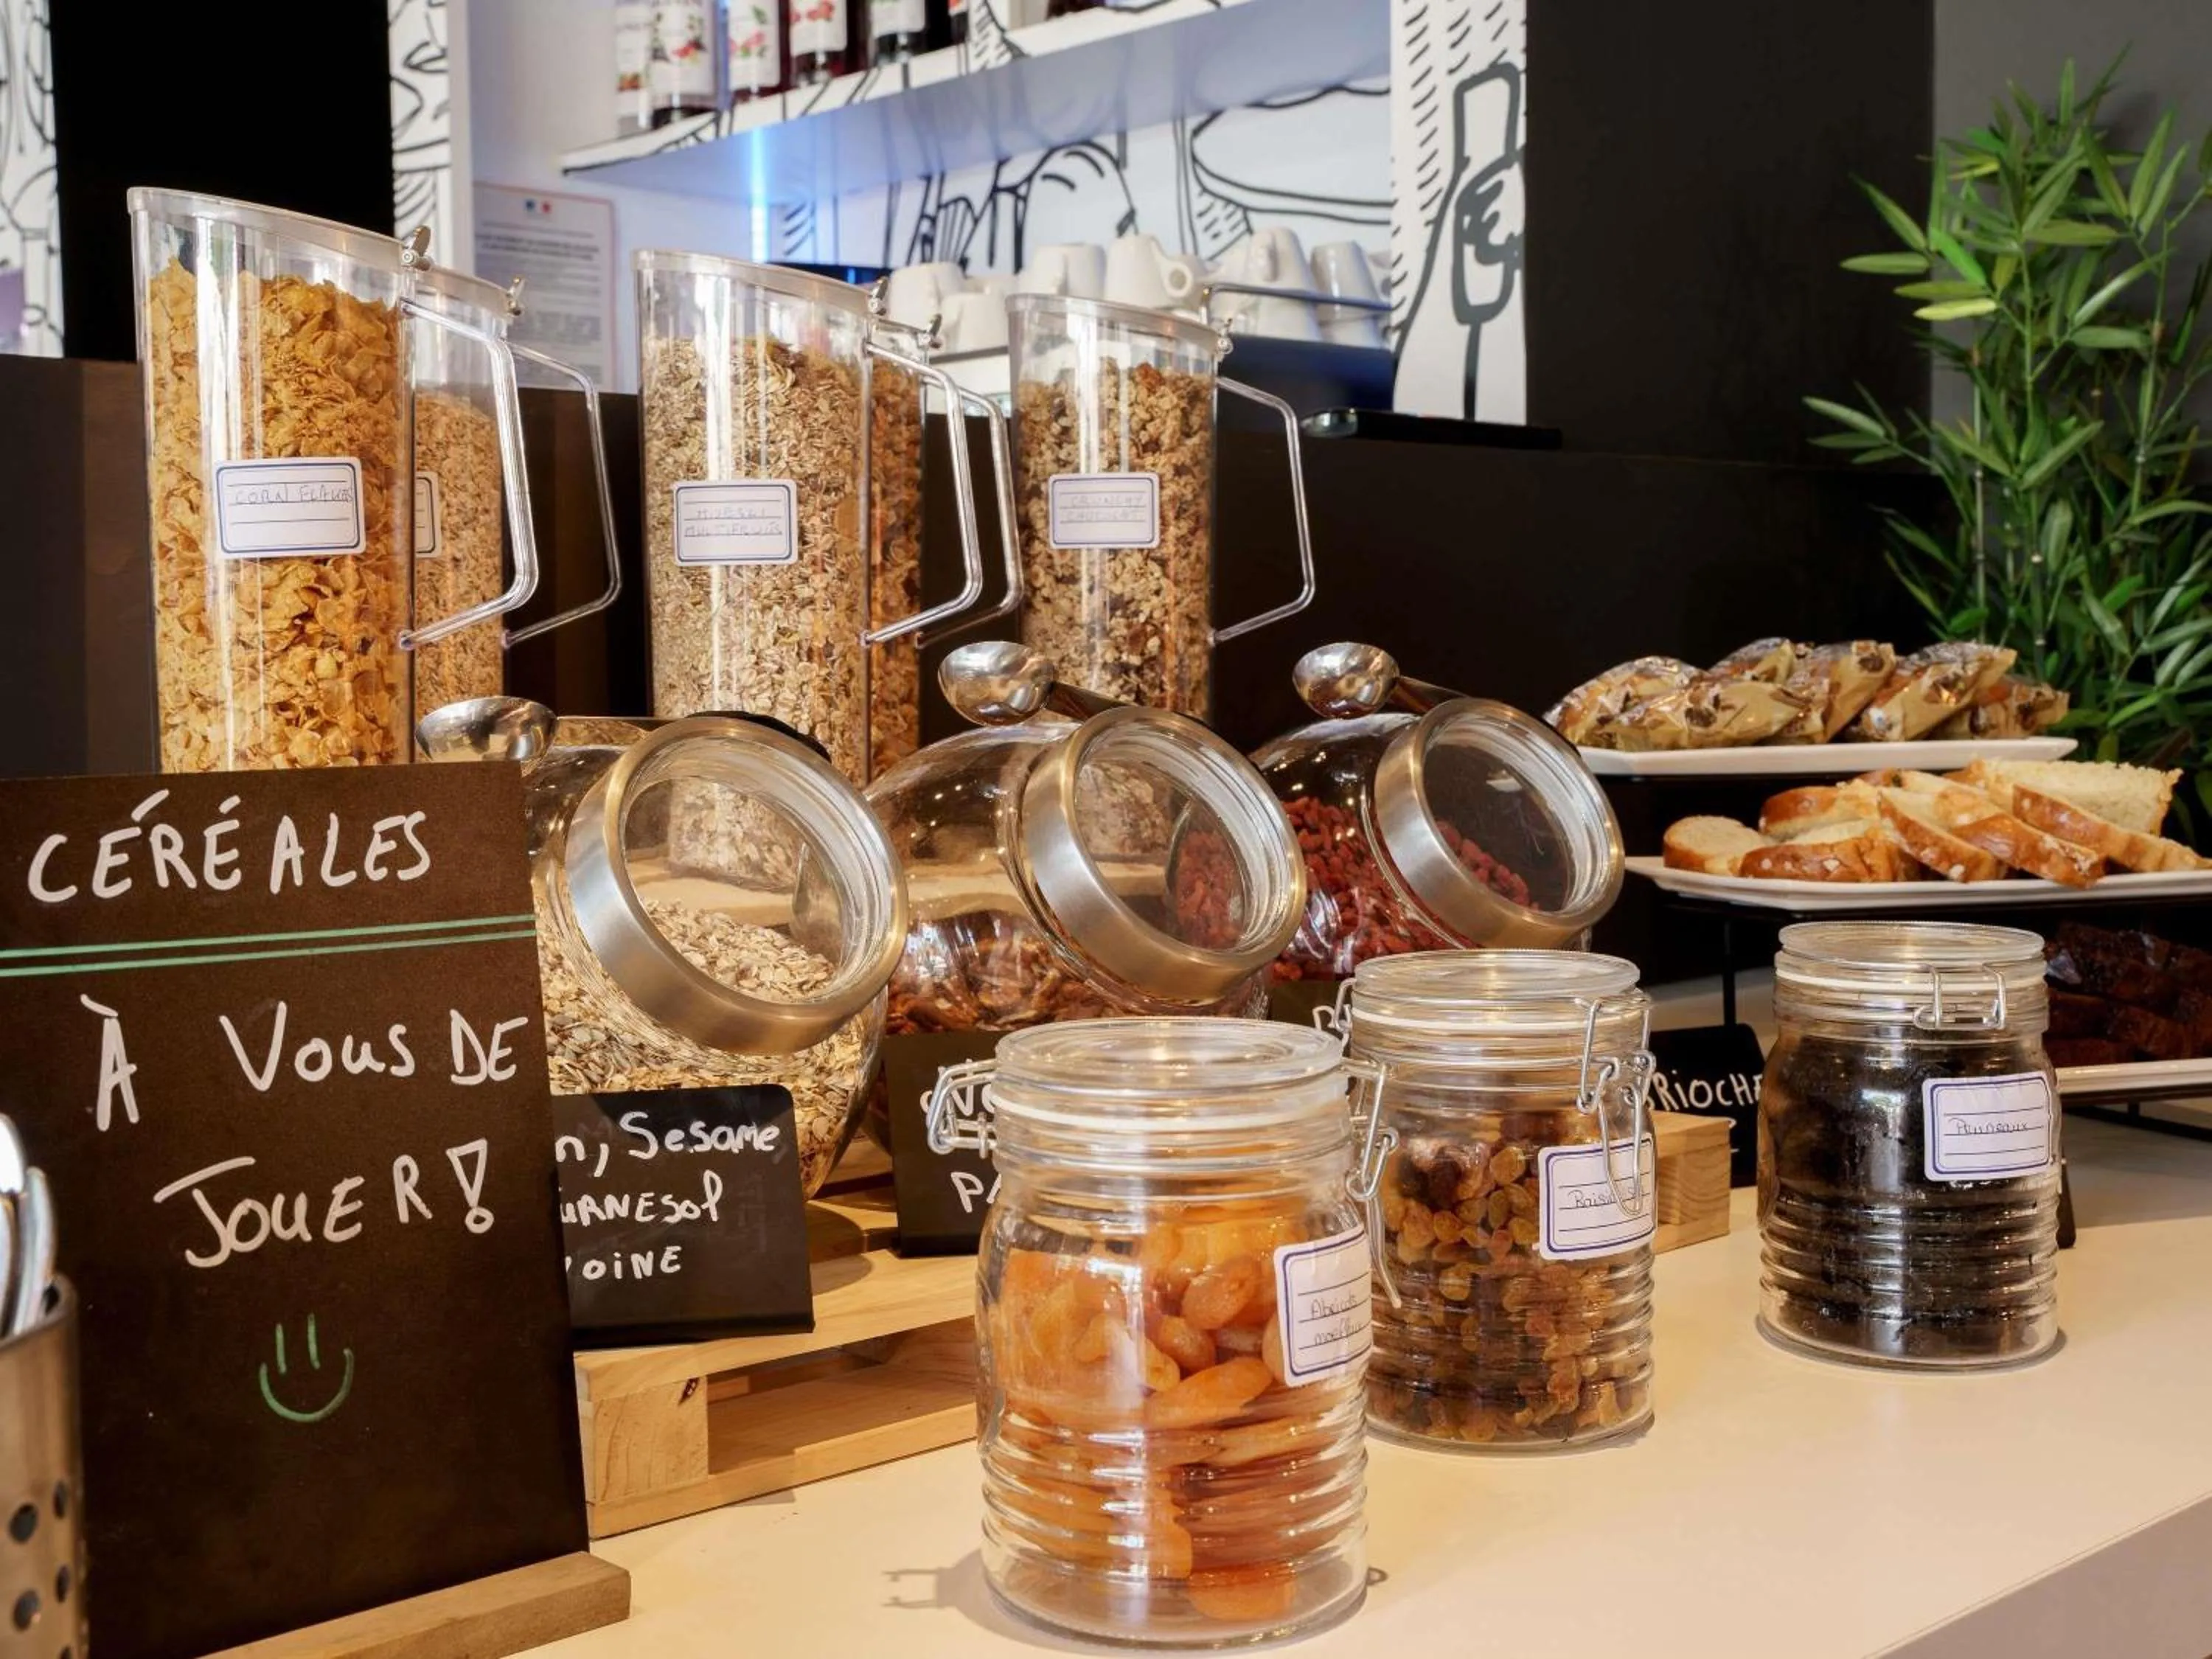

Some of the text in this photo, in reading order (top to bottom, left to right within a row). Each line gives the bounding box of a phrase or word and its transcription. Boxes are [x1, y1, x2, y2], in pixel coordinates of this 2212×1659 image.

[27, 789, 432, 903] CÉRÉALES
[80, 993, 140, 1132] À
[450, 1009, 529, 1085] DE
